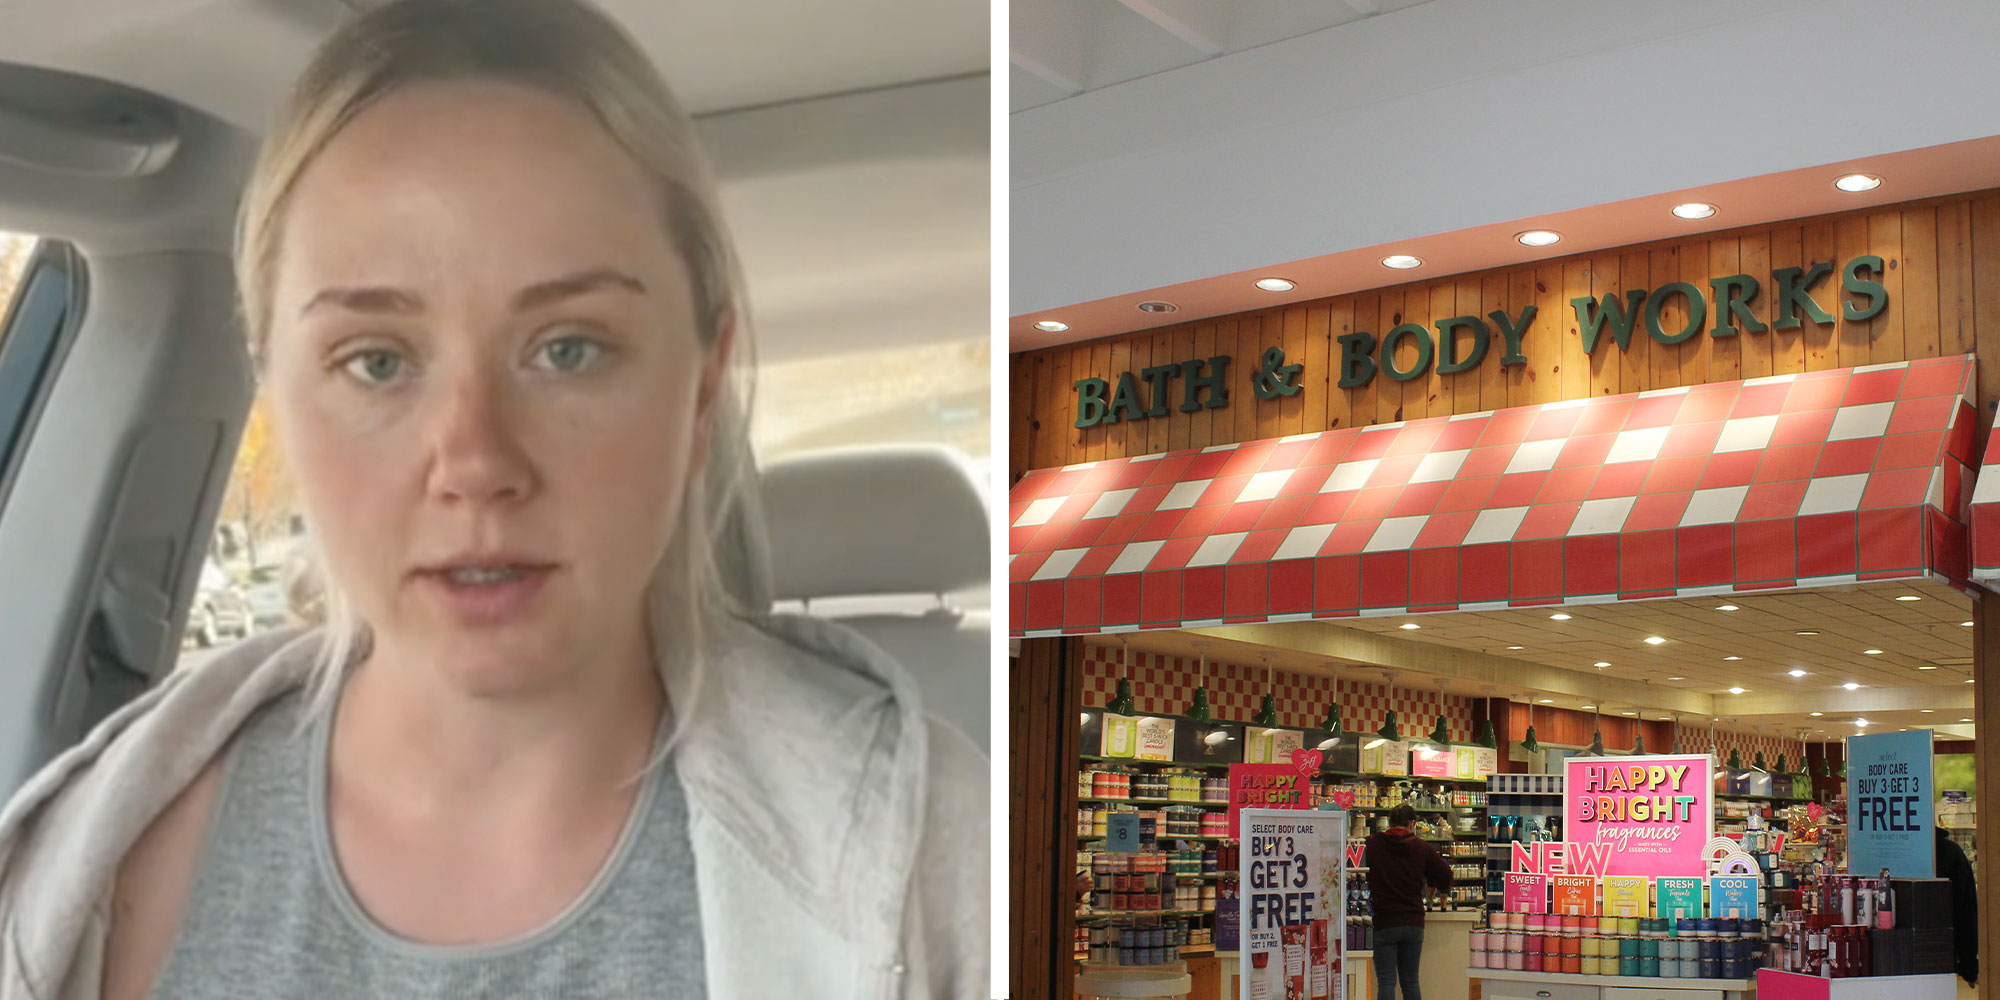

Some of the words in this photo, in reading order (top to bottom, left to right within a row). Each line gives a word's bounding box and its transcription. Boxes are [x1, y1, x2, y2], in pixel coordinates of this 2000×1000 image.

[1074, 355, 1231, 429] BATH
[1253, 346, 1304, 400] &
[1338, 305, 1538, 389] BODY
[1570, 254, 1889, 355] WORKS
[1869, 764, 1887, 776] BODY
[1889, 763, 1908, 775] CARE
[1241, 775, 1298, 789] HAPPY
[1585, 765, 1689, 792] HAPPY
[1858, 779, 1877, 794] BUY
[1912, 777, 1919, 793] 3
[1237, 790, 1302, 804] BRIGHT
[1578, 796, 1696, 822] BRIGHT
[1858, 796, 1921, 832] FREE
[1252, 824, 1276, 834] SELECT
[1278, 825, 1295, 834] BODY
[1297, 825, 1314, 834] CARE
[1596, 821, 1682, 852] fragrances
[1252, 836, 1281, 856] BUY
[1285, 836, 1294, 856] 3
[1511, 840, 1614, 883] NEW
[1510, 875, 1541, 885] SWEET
[1557, 878, 1592, 887] BRIGHT
[1610, 879, 1642, 888] HAPPY
[1664, 880, 1695, 889] FRESH
[1719, 880, 1749, 889] COOL
[1251, 892, 1315, 929] FREE
[1252, 941, 1261, 949] GET
